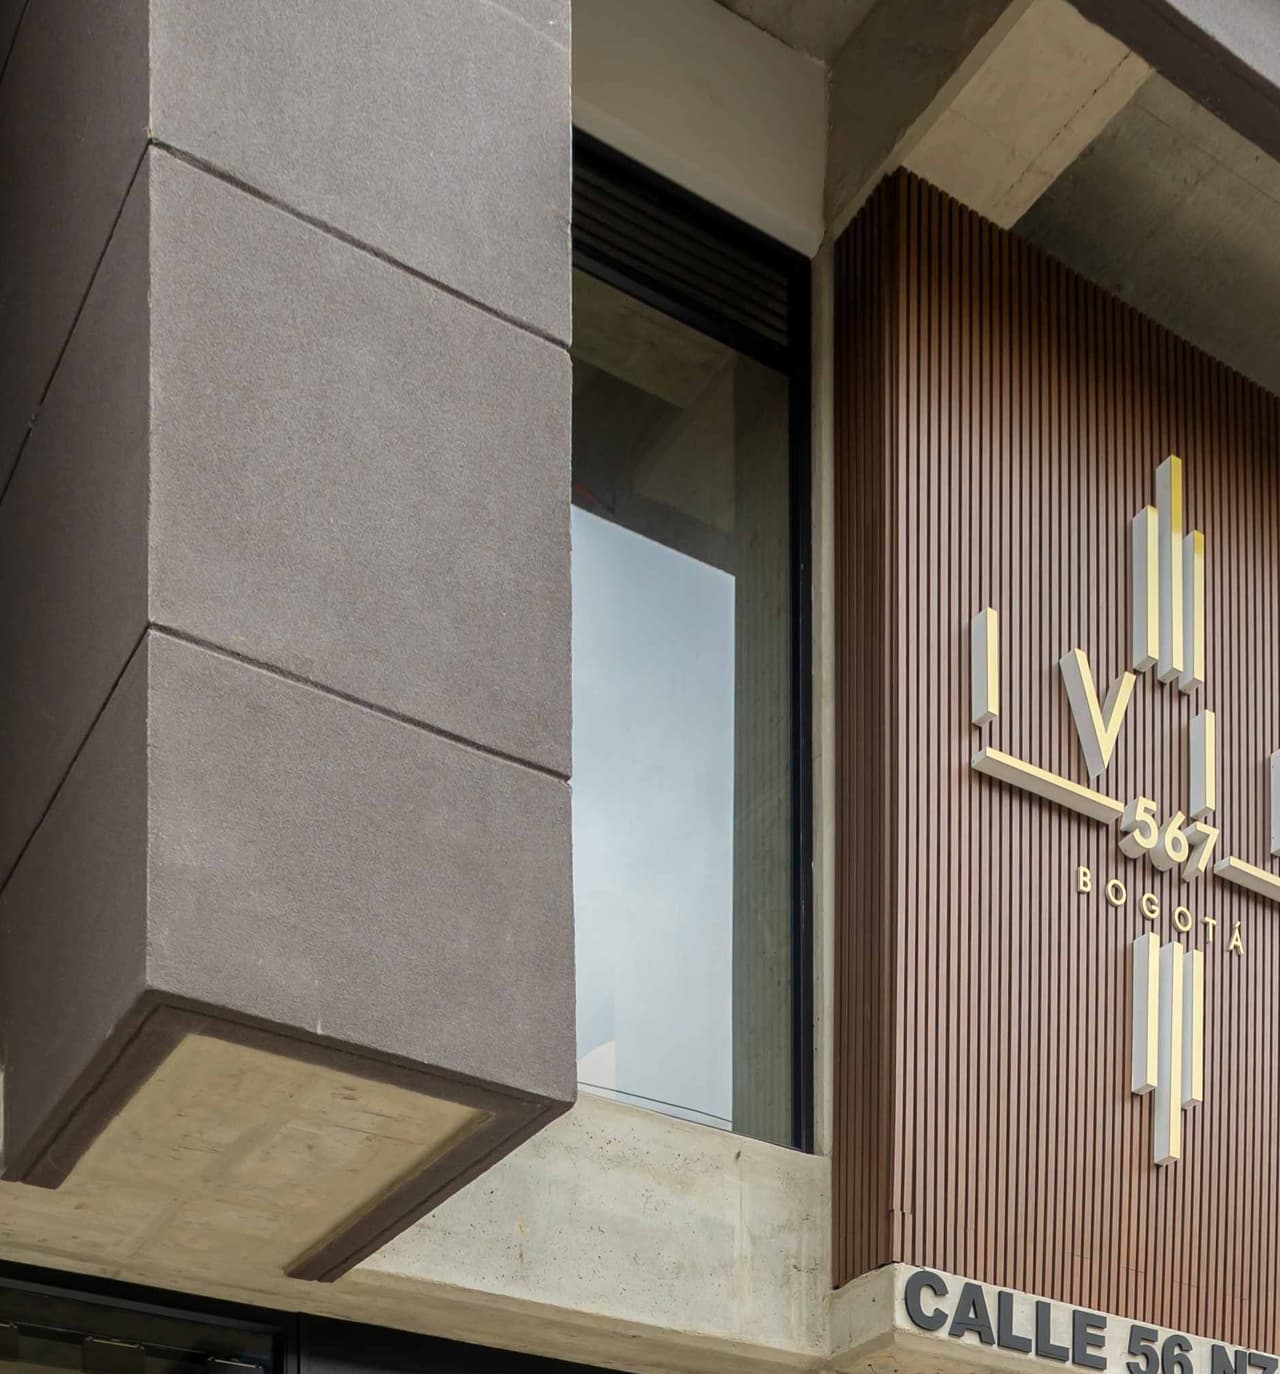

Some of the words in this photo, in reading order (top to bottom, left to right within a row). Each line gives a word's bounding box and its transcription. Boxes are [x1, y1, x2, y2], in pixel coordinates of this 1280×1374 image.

[1119, 796, 1219, 883] 567
[1077, 866, 1246, 957] BOGOTÁ
[904, 1269, 1108, 1370] CALLE
